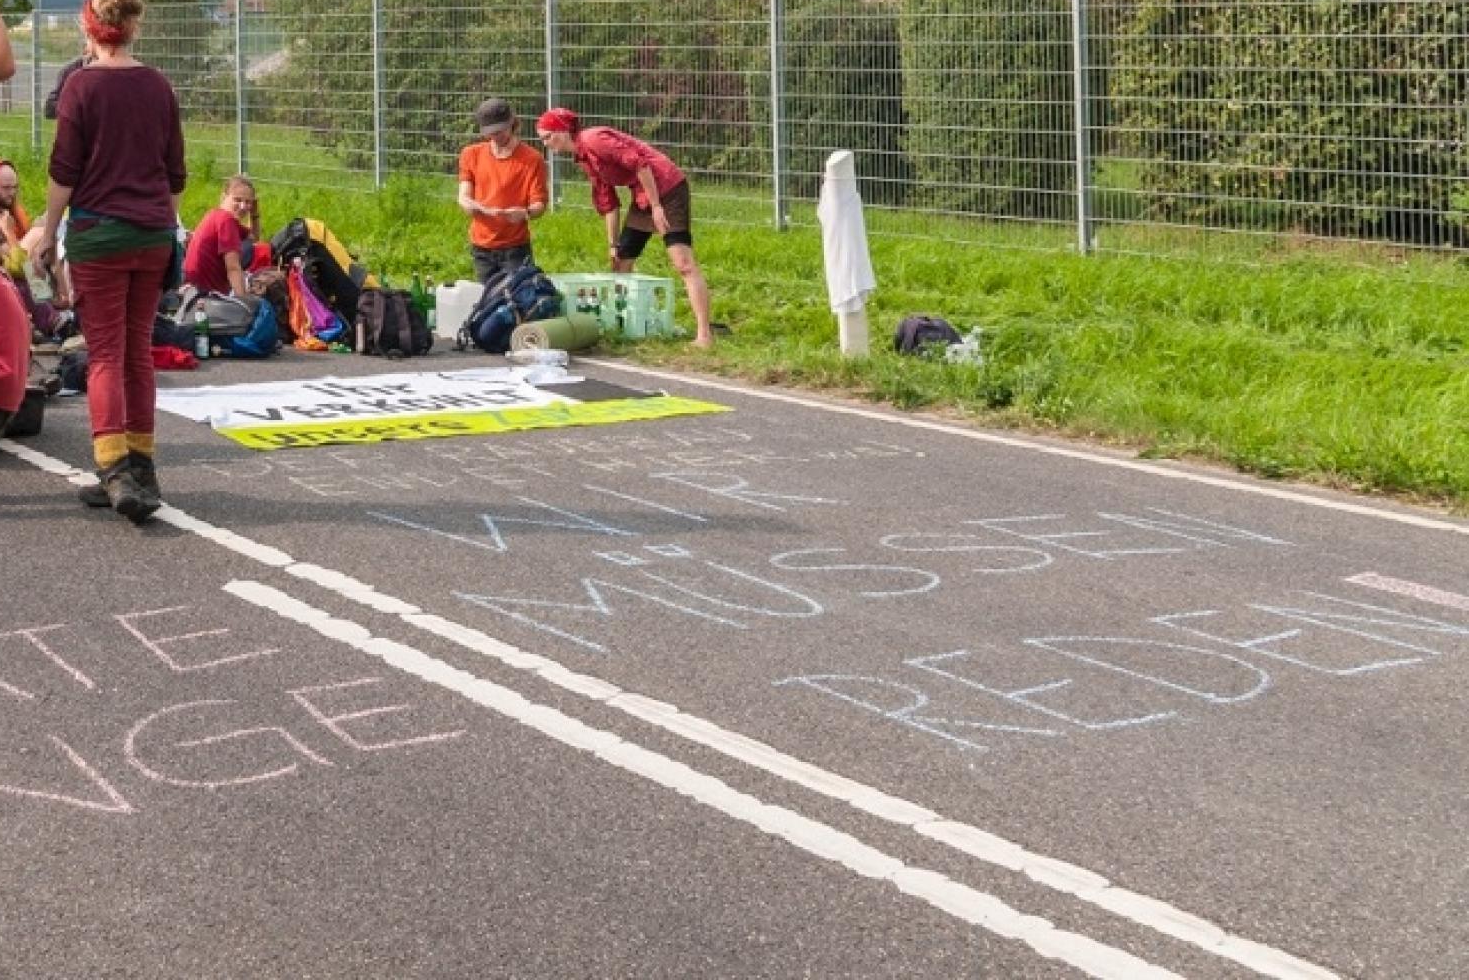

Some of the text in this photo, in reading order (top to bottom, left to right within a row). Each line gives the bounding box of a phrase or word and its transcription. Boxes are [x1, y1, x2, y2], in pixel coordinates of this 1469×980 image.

[365, 472, 848, 552] WIR
[449, 507, 1300, 653] MÜSSEN
[771, 590, 1469, 753] REDEN
